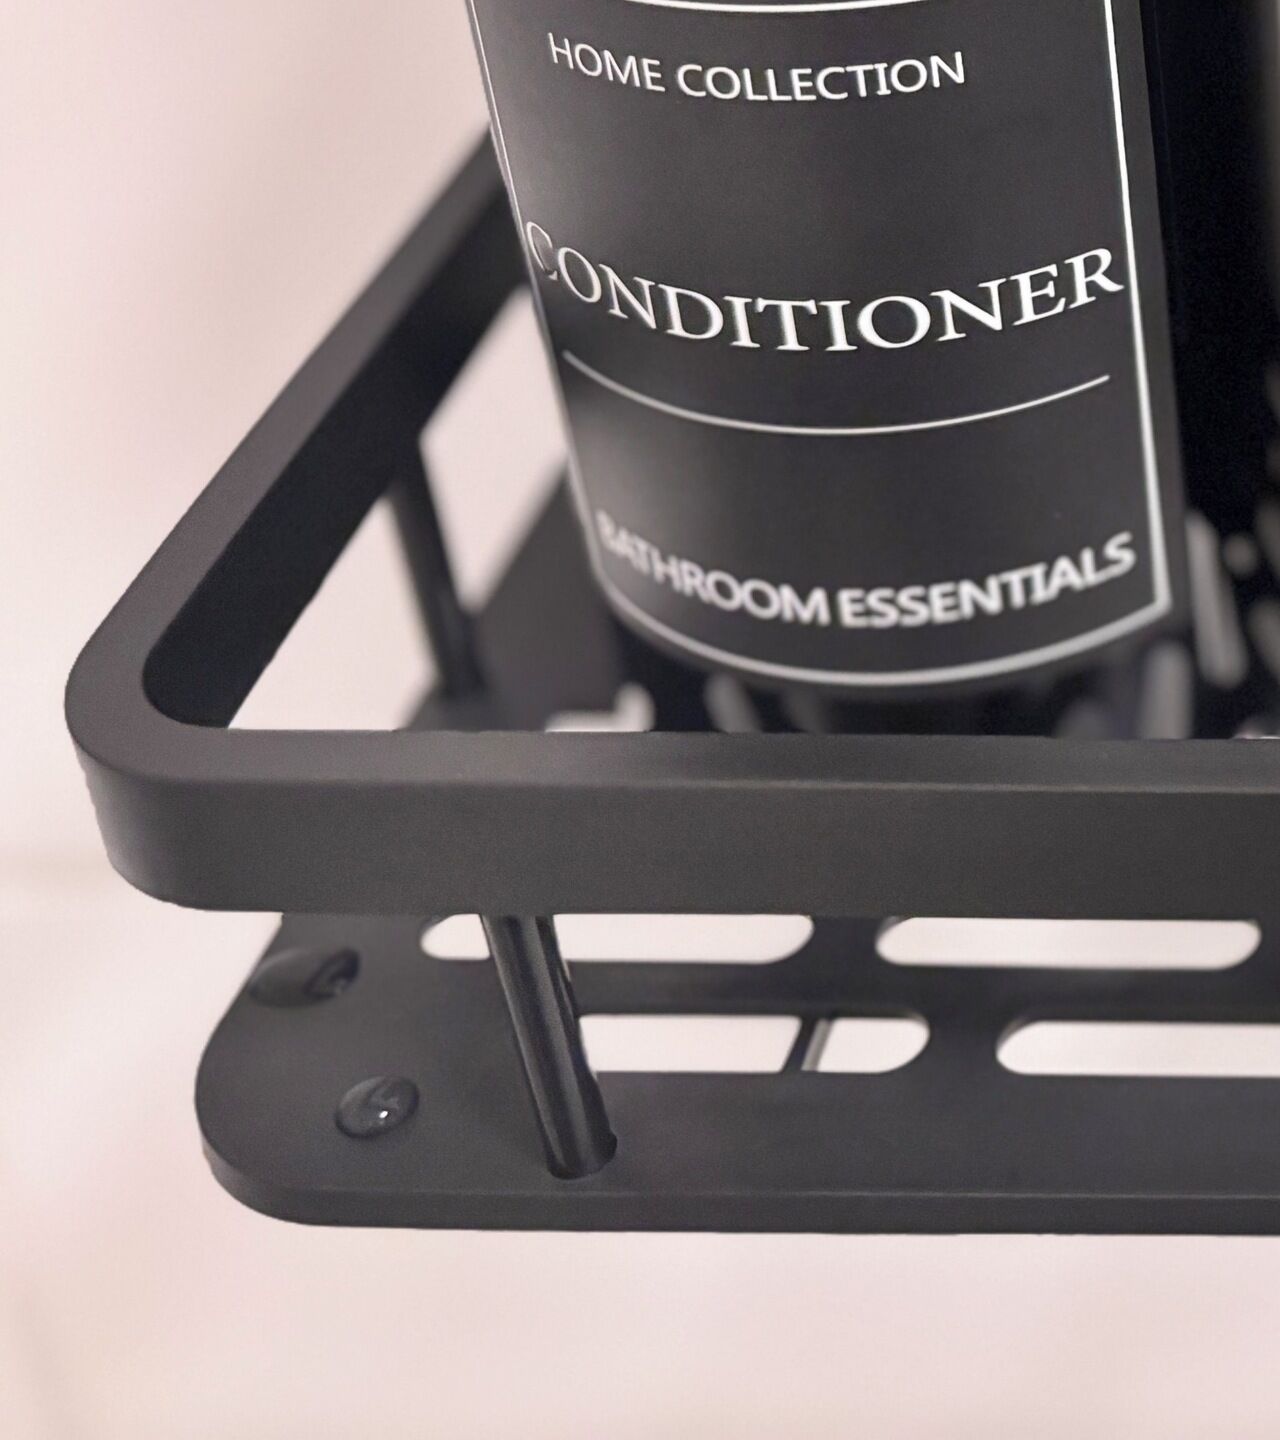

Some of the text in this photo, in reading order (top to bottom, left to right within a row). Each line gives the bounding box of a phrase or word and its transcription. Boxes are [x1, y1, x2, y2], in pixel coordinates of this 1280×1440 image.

[547, 31, 966, 102] HOME COLLECTION
[525, 220, 1126, 353] CONDITIONER
[596, 508, 1138, 628] BATHROOM ESSENTIALS
